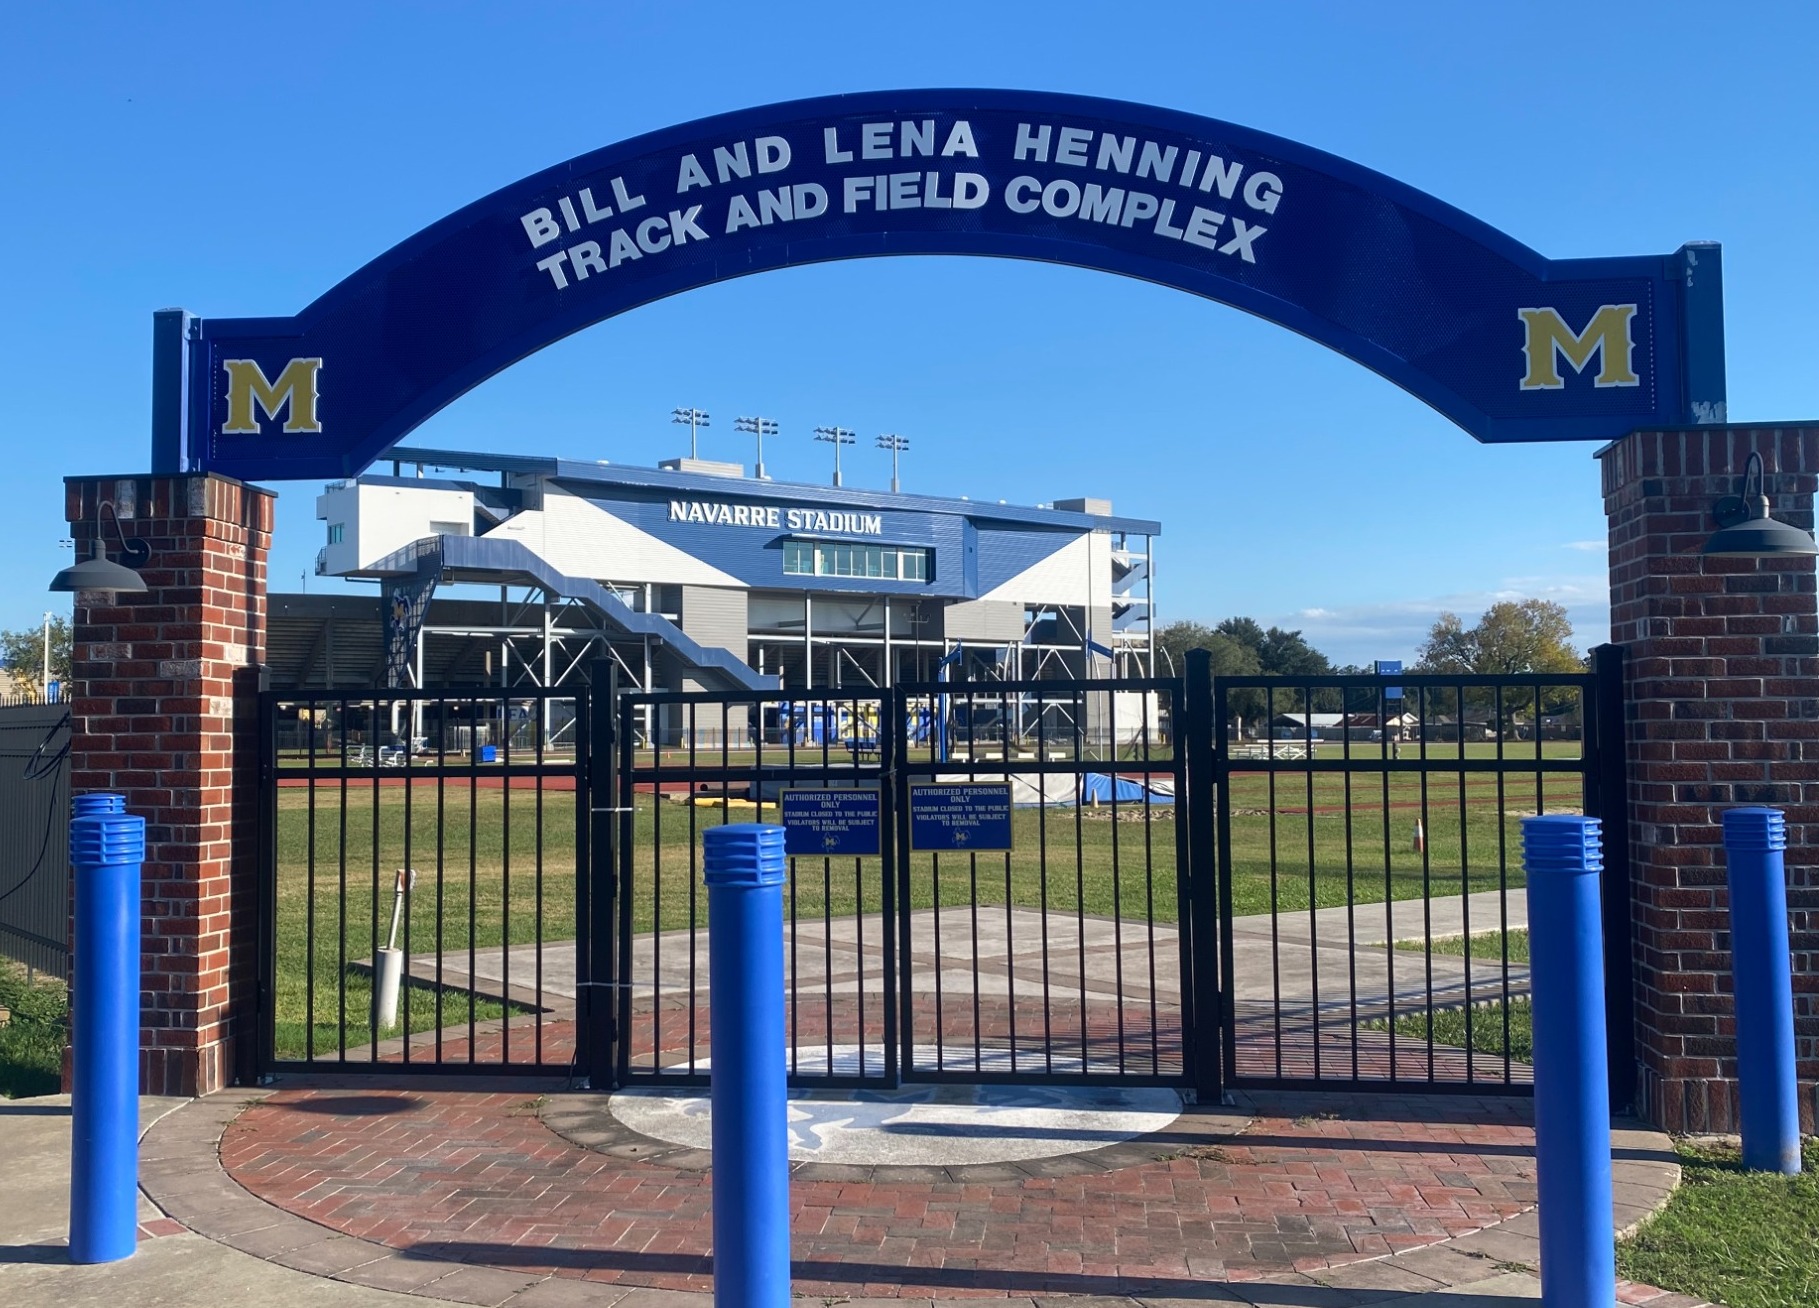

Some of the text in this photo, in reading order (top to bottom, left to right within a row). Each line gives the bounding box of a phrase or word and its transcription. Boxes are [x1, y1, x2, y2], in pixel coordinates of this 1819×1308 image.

[520, 119, 1284, 249] BILL AND LENA HENNING
[536, 171, 1268, 291] TRACK AND FIELD COMPLEX
[1518, 303, 1640, 391] M
[222, 357, 322, 434] M
[669, 500, 882, 535] NAVARRE STADIUM
[784, 793, 878, 802] AUTHORIZED PERSONNEL
[820, 801, 841, 809] ONLY
[912, 787, 1008, 796] AUTHORIZED PERSONNEL
[950, 795, 971, 803] ONLY
